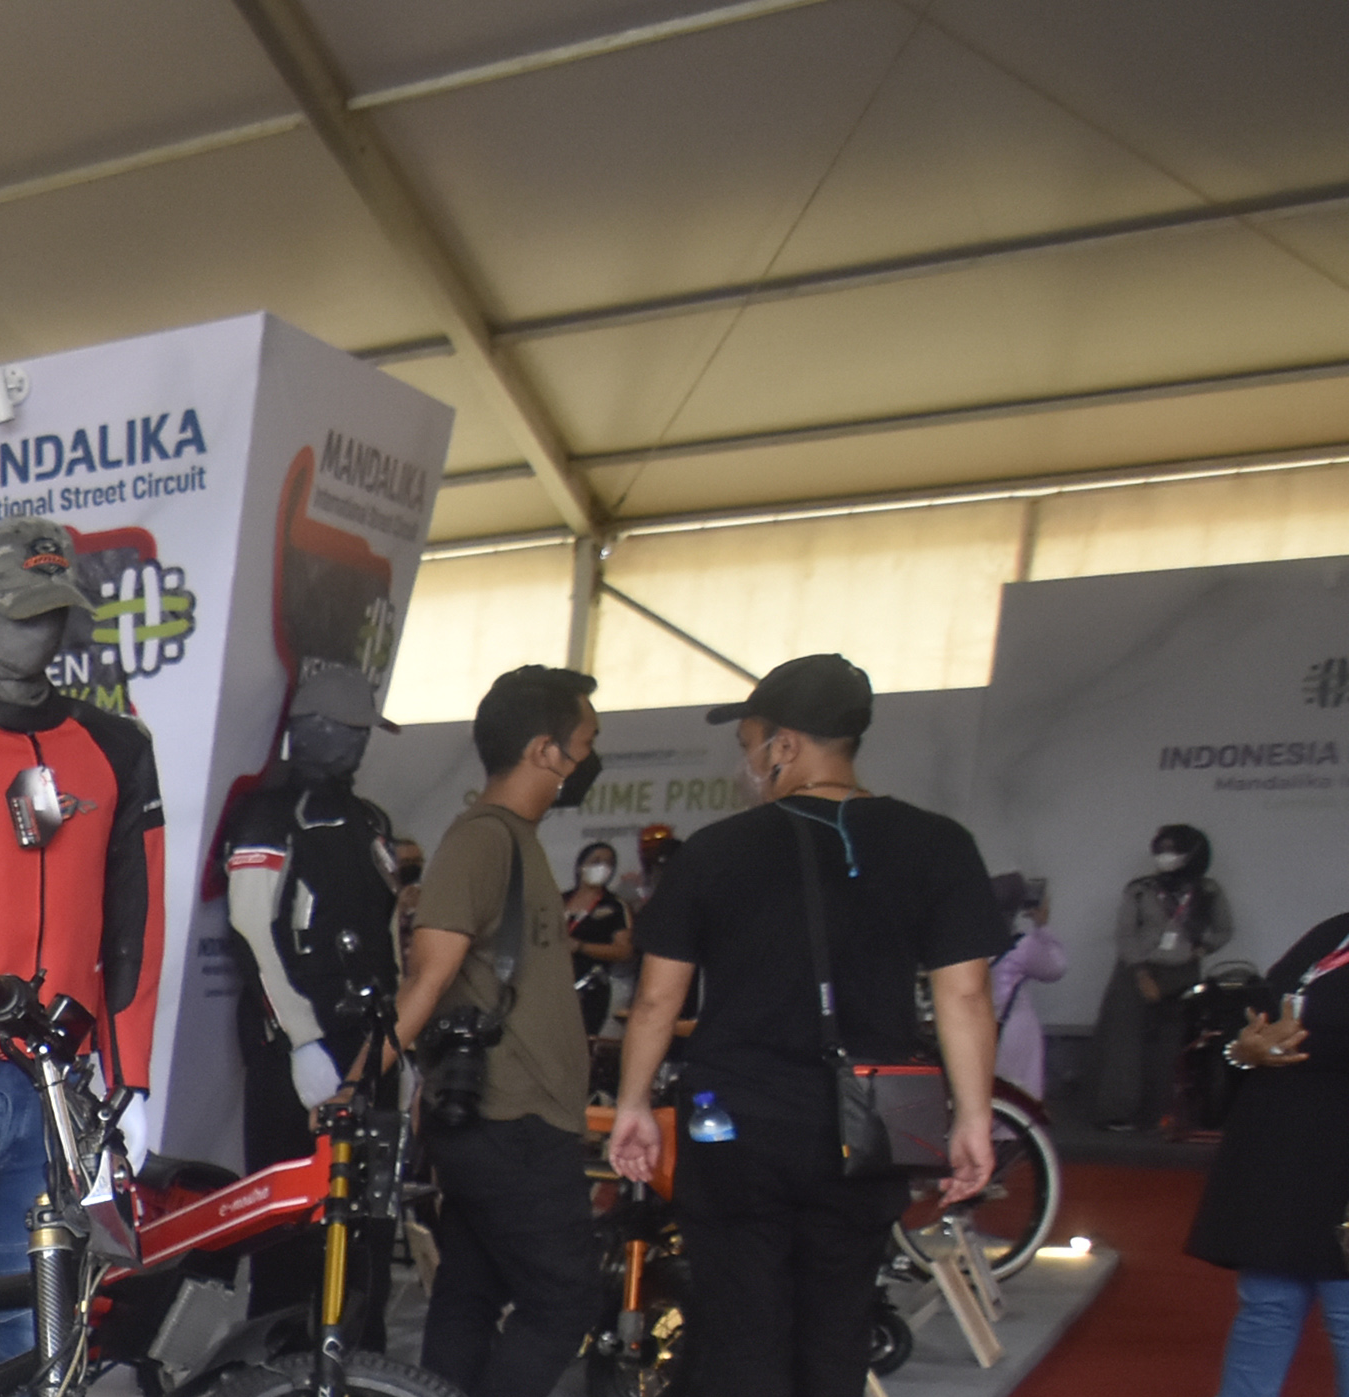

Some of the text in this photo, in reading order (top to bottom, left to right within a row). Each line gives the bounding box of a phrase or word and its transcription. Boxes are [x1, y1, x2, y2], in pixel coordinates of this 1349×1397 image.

[59, 478, 127, 513] Street
[132, 466, 207, 500] Circuit
[319, 428, 426, 513] MANDALIKA
[1159, 741, 1340, 770] INDONESIA
[577, 781, 653, 815] RIME
